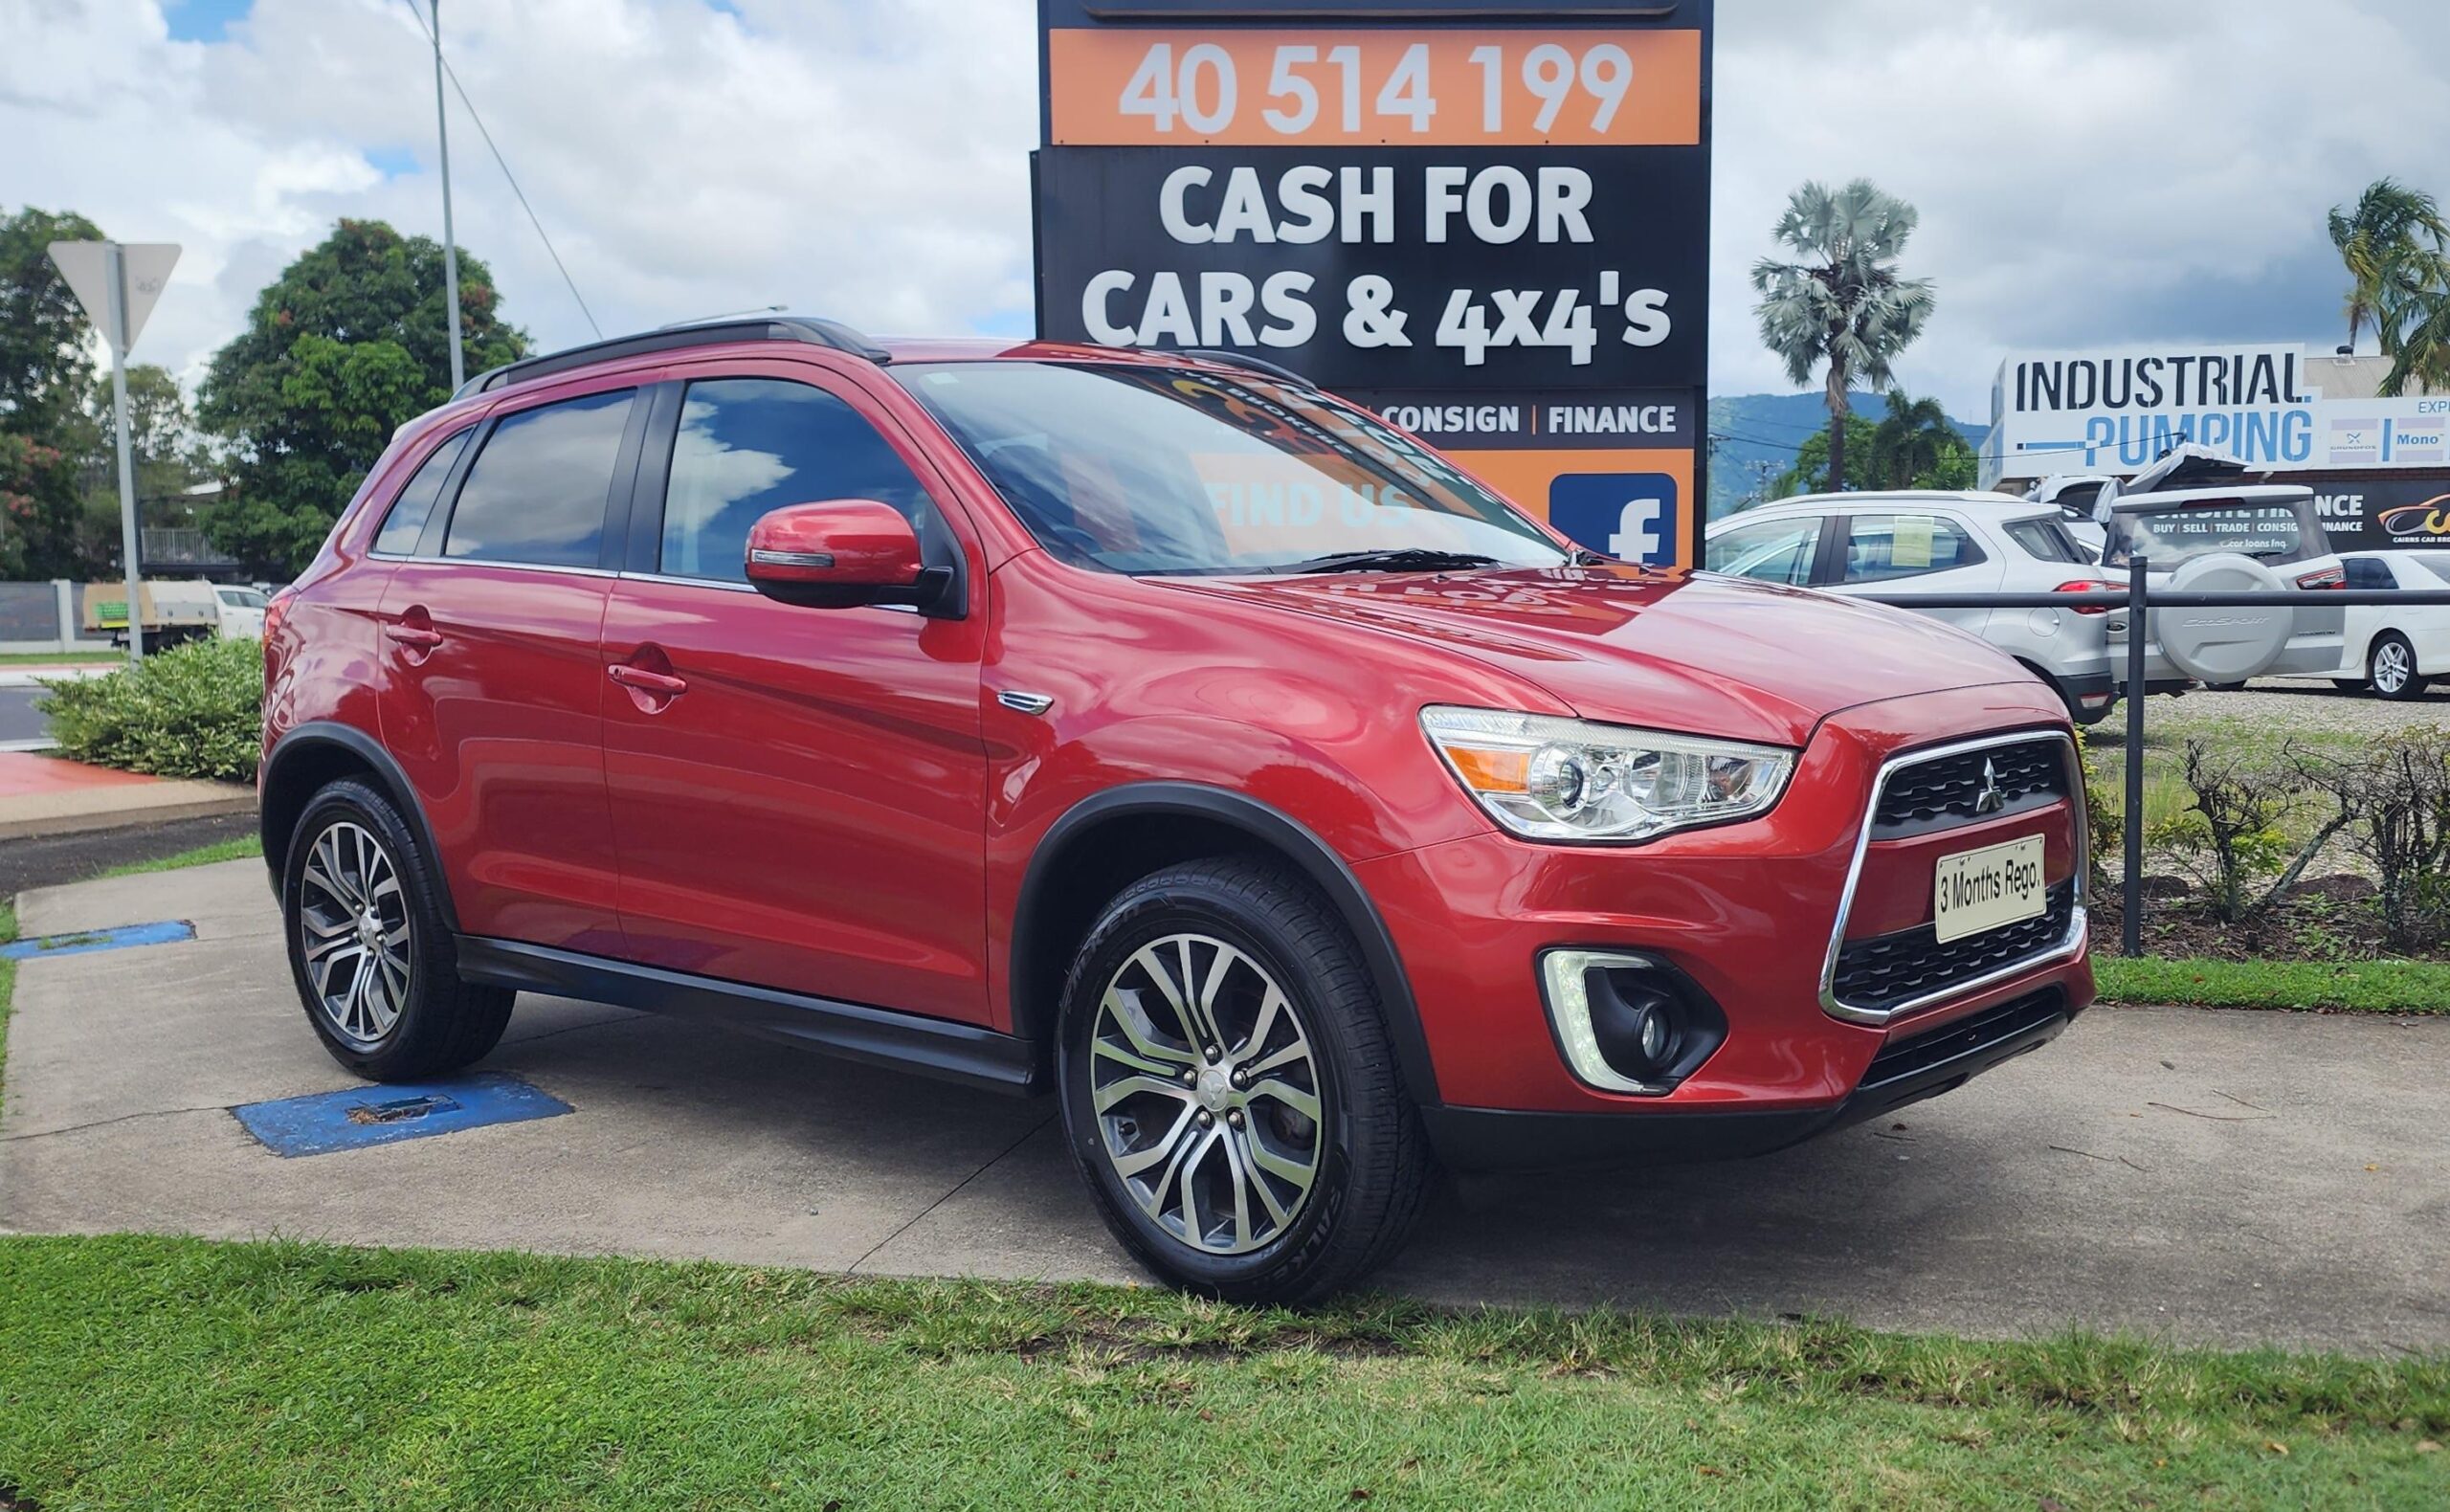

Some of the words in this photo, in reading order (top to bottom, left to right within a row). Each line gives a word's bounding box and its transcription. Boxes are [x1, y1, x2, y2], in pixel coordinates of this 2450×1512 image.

[1119, 43, 1236, 135] 40
[1261, 43, 1437, 135] 514
[1468, 43, 1634, 135] 199
[1159, 165, 1394, 245] CASH
[1425, 165, 1594, 245] FOR
[1081, 270, 1319, 348] CARS
[1342, 274, 1414, 348] &
[2016, 352, 2304, 412] INDUSTRIAL
[2418, 400, 2450, 413] EXP
[1382, 405, 1520, 433] CONSIGN
[1548, 405, 1677, 434] FINANCE
[2084, 410, 2313, 467] PUMPING
[2396, 434, 2439, 445] Mono
[1203, 481, 1324, 527] FIND
[1342, 482, 1414, 528] US
[2153, 523, 2175, 534] BUY
[2182, 523, 2208, 533] SELL
[2215, 523, 2250, 533] TRADE
[2257, 522, 2299, 532] CONSIG
[2245, 539, 2269, 548] loans
[1940, 877, 1949, 913] 3
[1953, 864, 2001, 910] Months
[2005, 858, 2040, 901] Rego.
